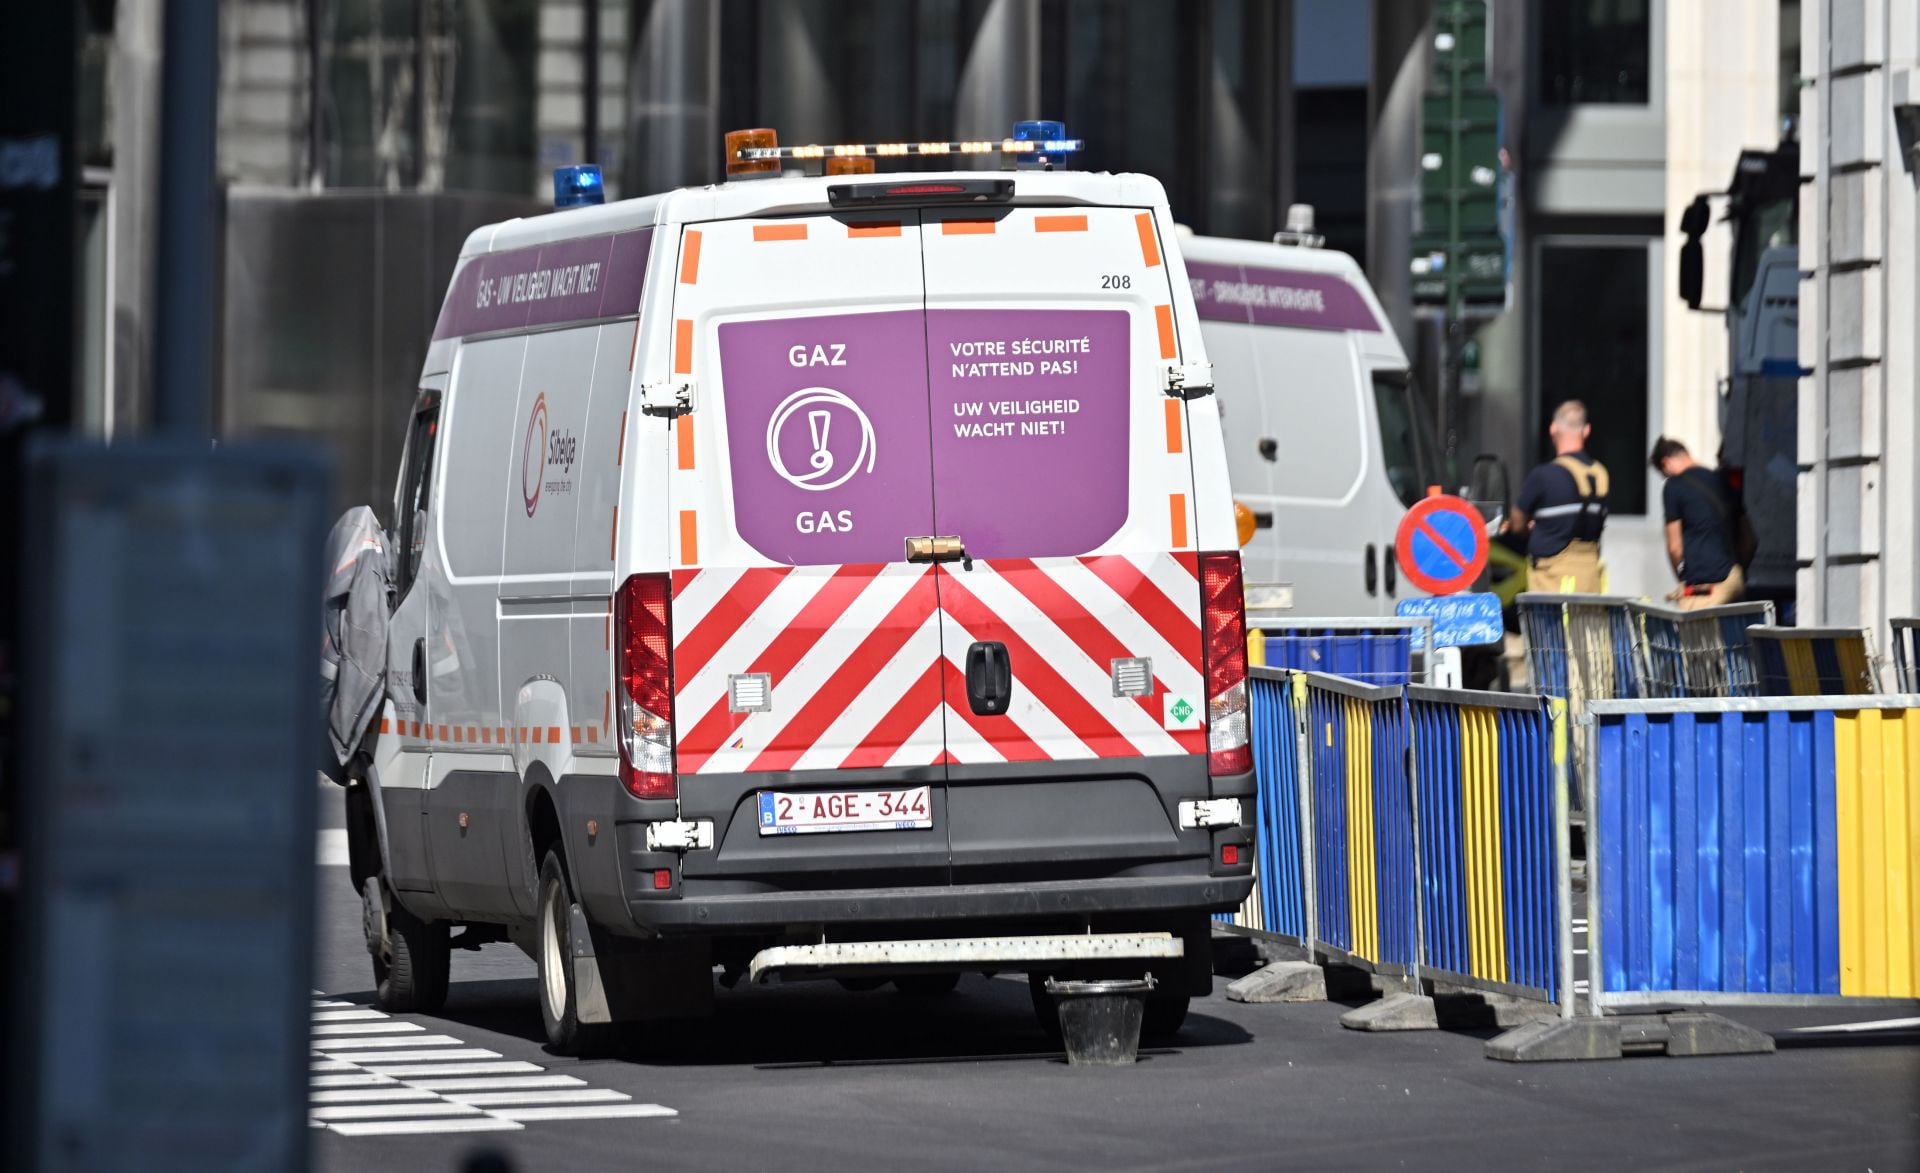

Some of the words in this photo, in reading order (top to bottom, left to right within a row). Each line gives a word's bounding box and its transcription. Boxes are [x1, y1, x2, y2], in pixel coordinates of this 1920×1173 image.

[476, 278, 494, 308] GAS
[497, 275, 514, 305] UW
[511, 269, 552, 303] VEILIGHEID
[550, 265, 580, 297] WACHT
[577, 262, 601, 293] NIET!
[1101, 274, 1131, 290] 208
[788, 343, 847, 367] GAZ
[950, 341, 1006, 357] VOTRE
[1011, 336, 1091, 355] SÉCURITÉ
[951, 362, 1035, 378] N'ATTEND
[1040, 360, 1078, 375] PAS!
[953, 402, 983, 416] UW
[988, 399, 1080, 416] VEILIGHEID
[953, 422, 1015, 438] WACHT
[1021, 420, 1065, 436] NIET!
[548, 428, 576, 474] Sibelga
[796, 509, 853, 534] GAS
[1173, 705, 1191, 716] CNG
[763, 812, 773, 823] B
